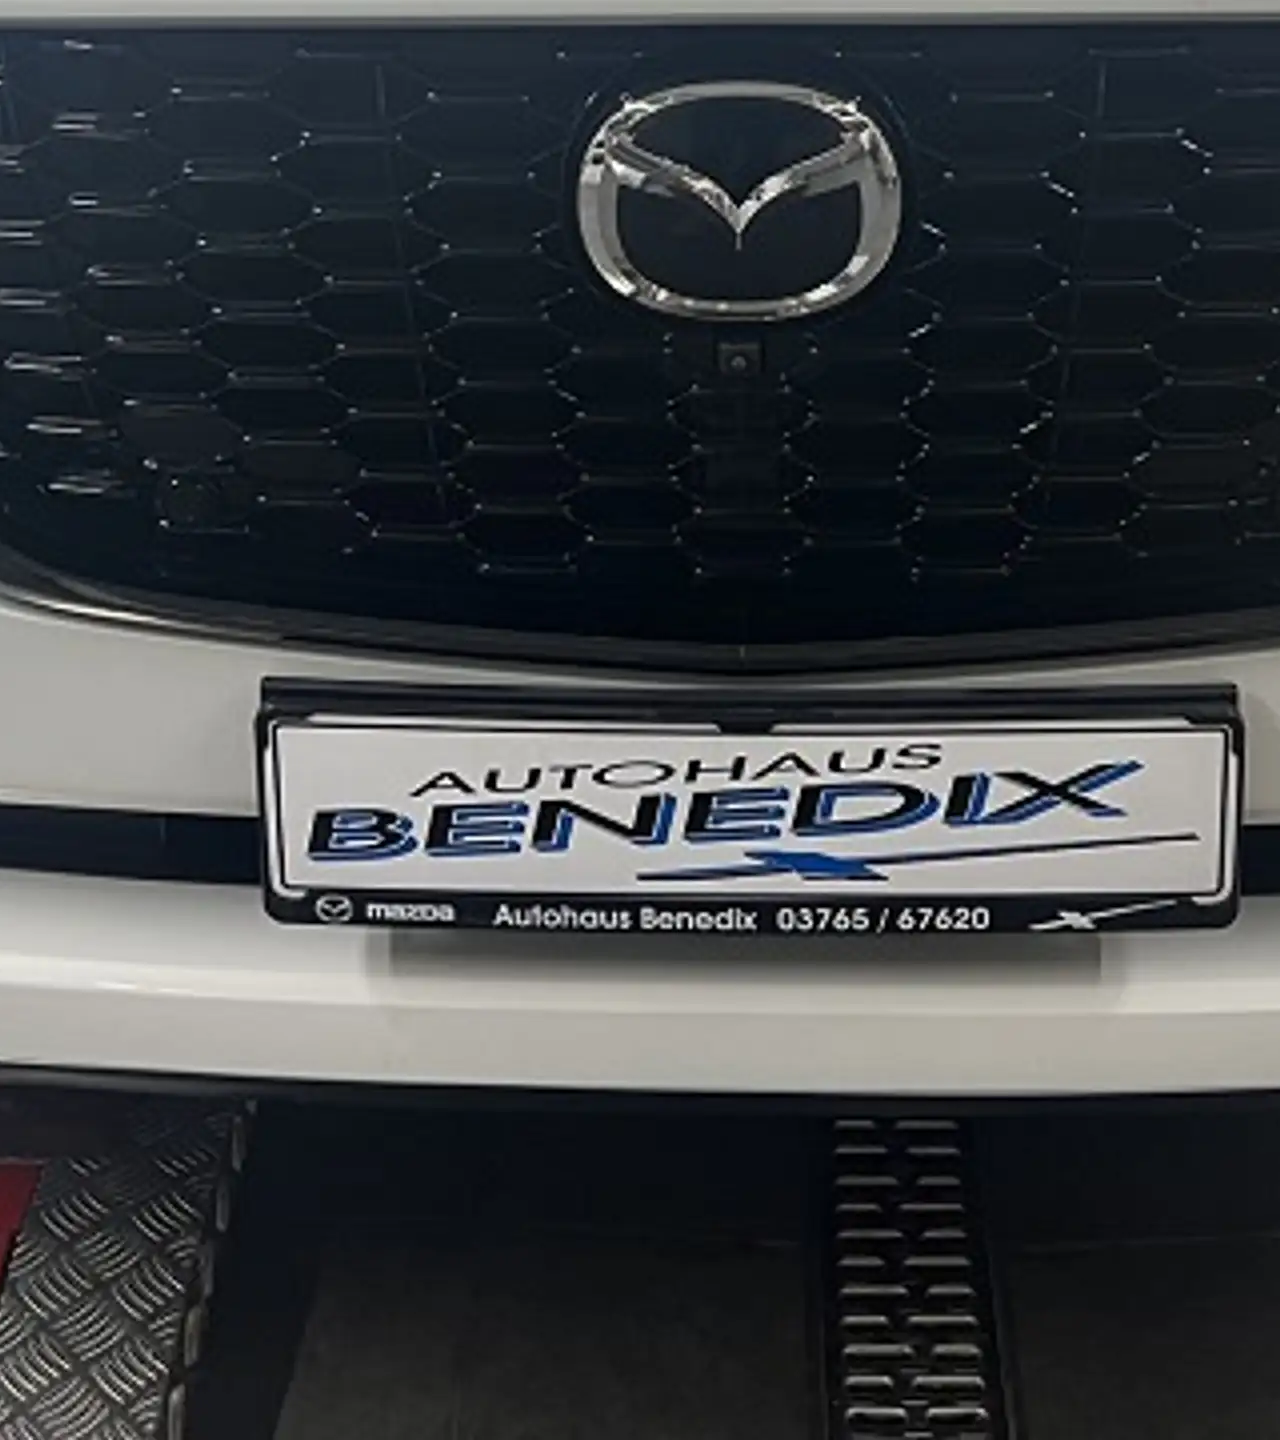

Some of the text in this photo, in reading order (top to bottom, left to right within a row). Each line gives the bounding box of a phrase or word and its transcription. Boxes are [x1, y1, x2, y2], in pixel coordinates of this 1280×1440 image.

[409, 742, 943, 796] AUTOHAUS
[306, 759, 1145, 862] BENEDIX
[493, 903, 631, 929] Autohaus
[639, 905, 758, 931] Benedix
[776, 906, 873, 931] 03765
[896, 906, 991, 931] 67620
